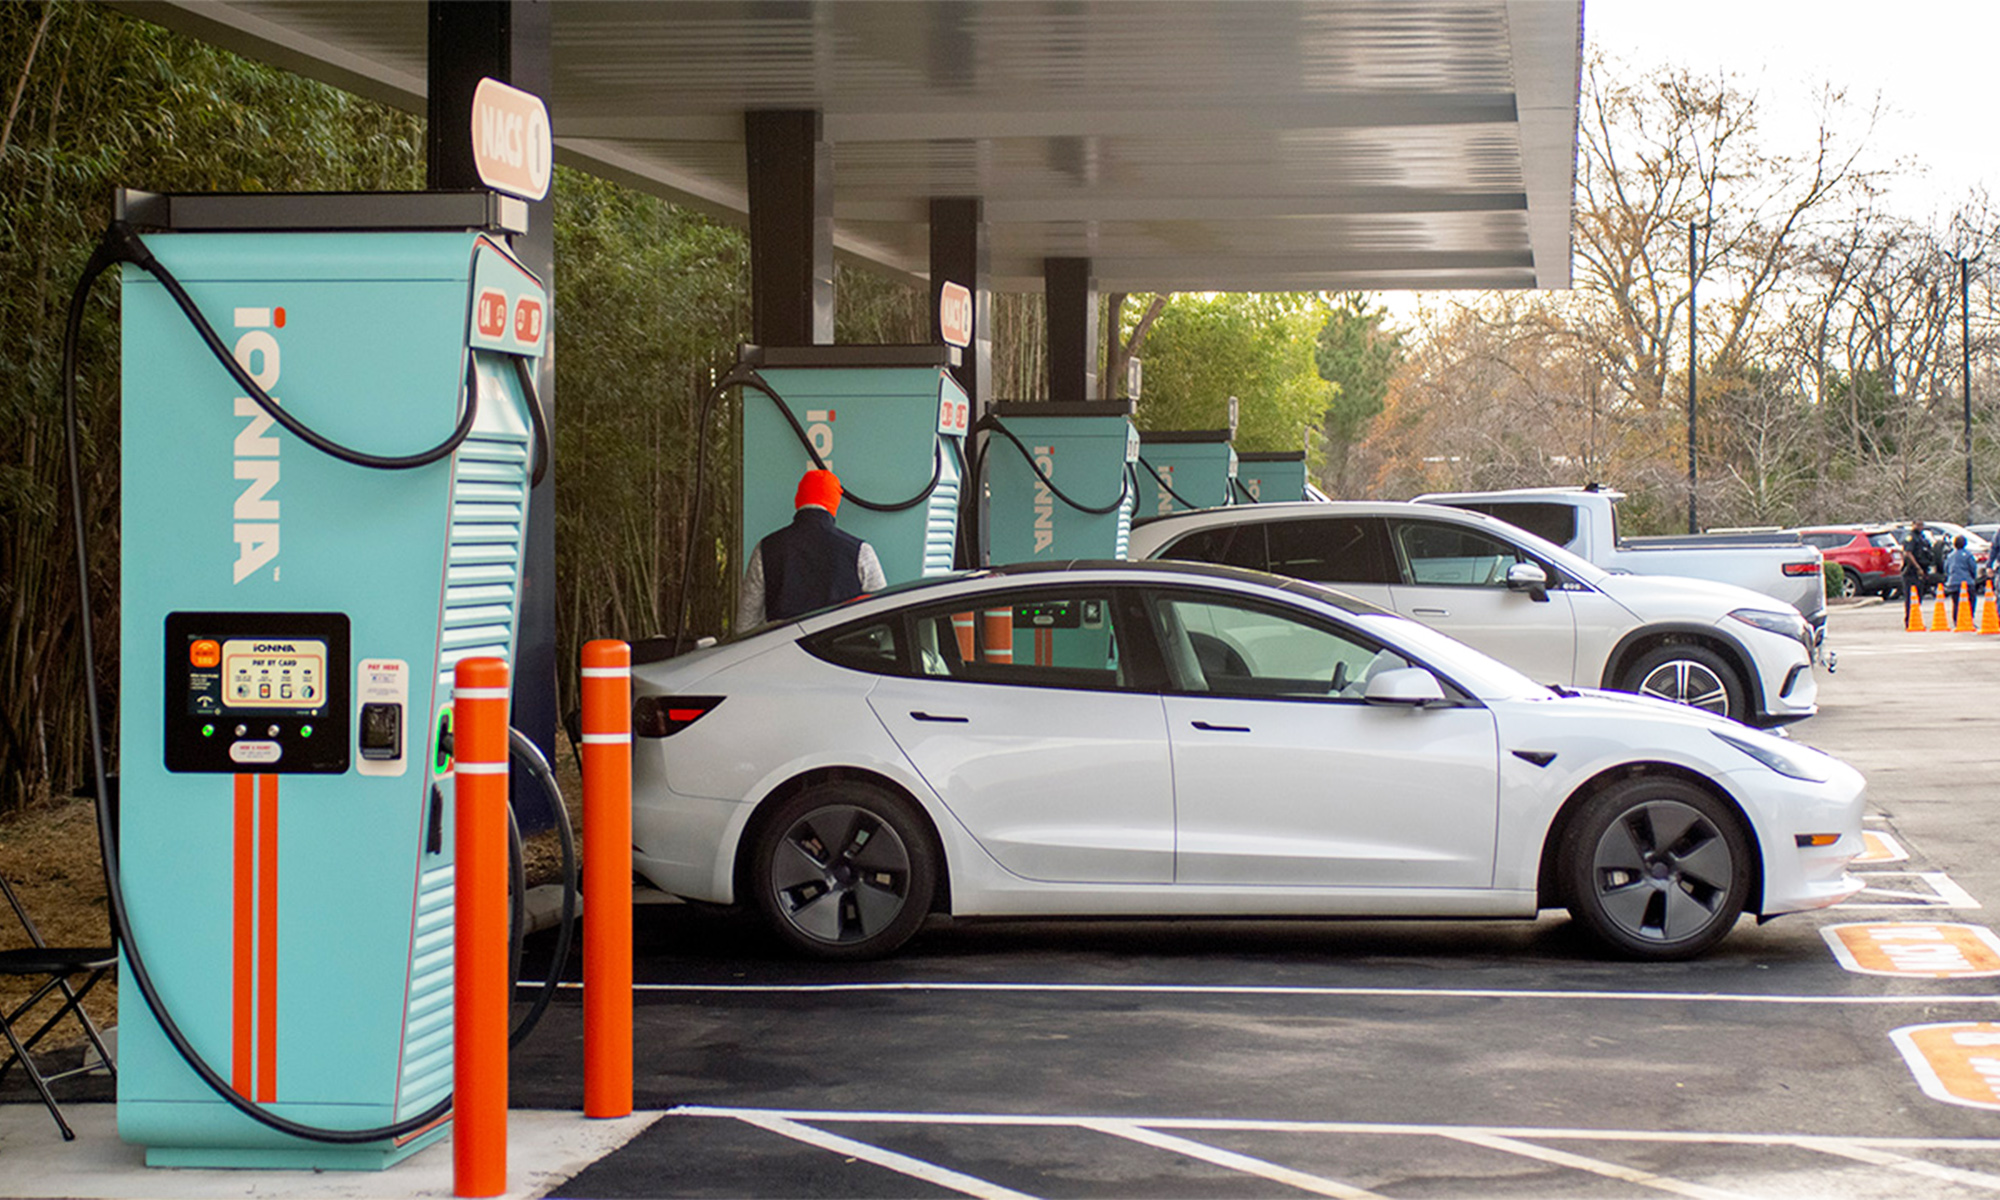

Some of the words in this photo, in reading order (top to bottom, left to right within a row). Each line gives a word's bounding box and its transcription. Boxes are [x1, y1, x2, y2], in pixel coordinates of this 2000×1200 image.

[481, 103, 523, 169] NACS
[252, 659, 266, 667] PAY
[267, 659, 275, 667] BY
[278, 659, 297, 667] CARD
